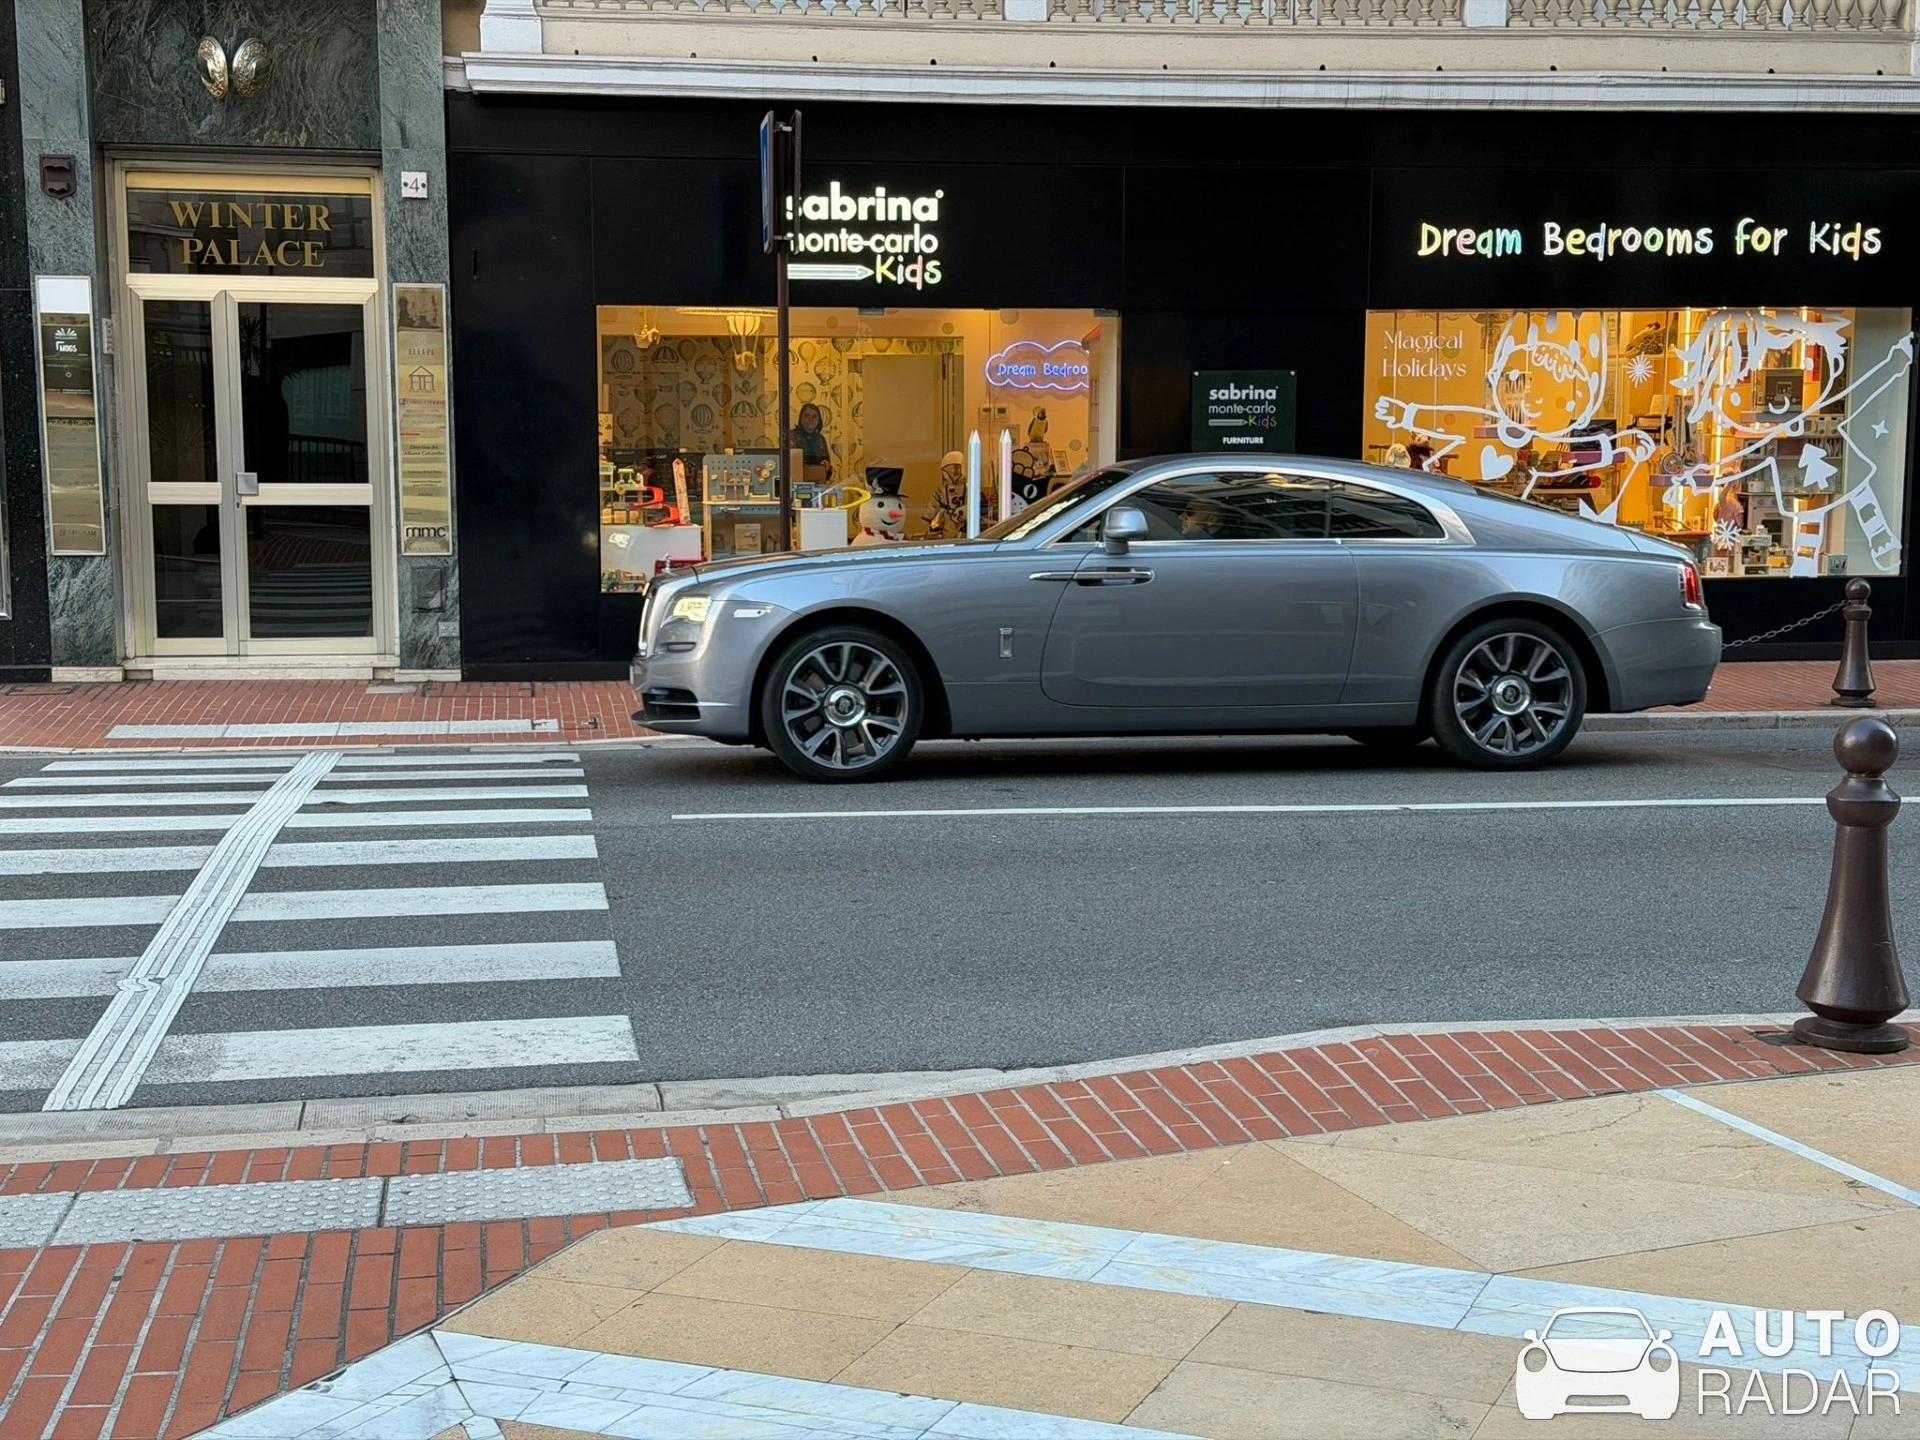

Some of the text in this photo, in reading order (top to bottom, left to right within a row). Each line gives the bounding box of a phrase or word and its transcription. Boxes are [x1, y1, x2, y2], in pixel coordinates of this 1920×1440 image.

[409, 178, 420, 192] 4
[169, 200, 332, 231] WINTER
[1417, 222, 1523, 258] Dream
[1543, 222, 1714, 262] Bedrooms
[1809, 220, 1881, 261] Kids
[179, 238, 325, 268] PALACE
[876, 254, 943, 291] Kids
[1383, 330, 1463, 353] Magical
[997, 363, 1036, 377] Dream
[1383, 357, 1467, 381] Holidays
[1208, 382, 1277, 400] sabrina
[1208, 400, 1277, 414] monte-carlo
[1248, 414, 1277, 430] Kids
[1222, 436, 1264, 444] FURNITURE
[405, 526, 447, 538] mmc
